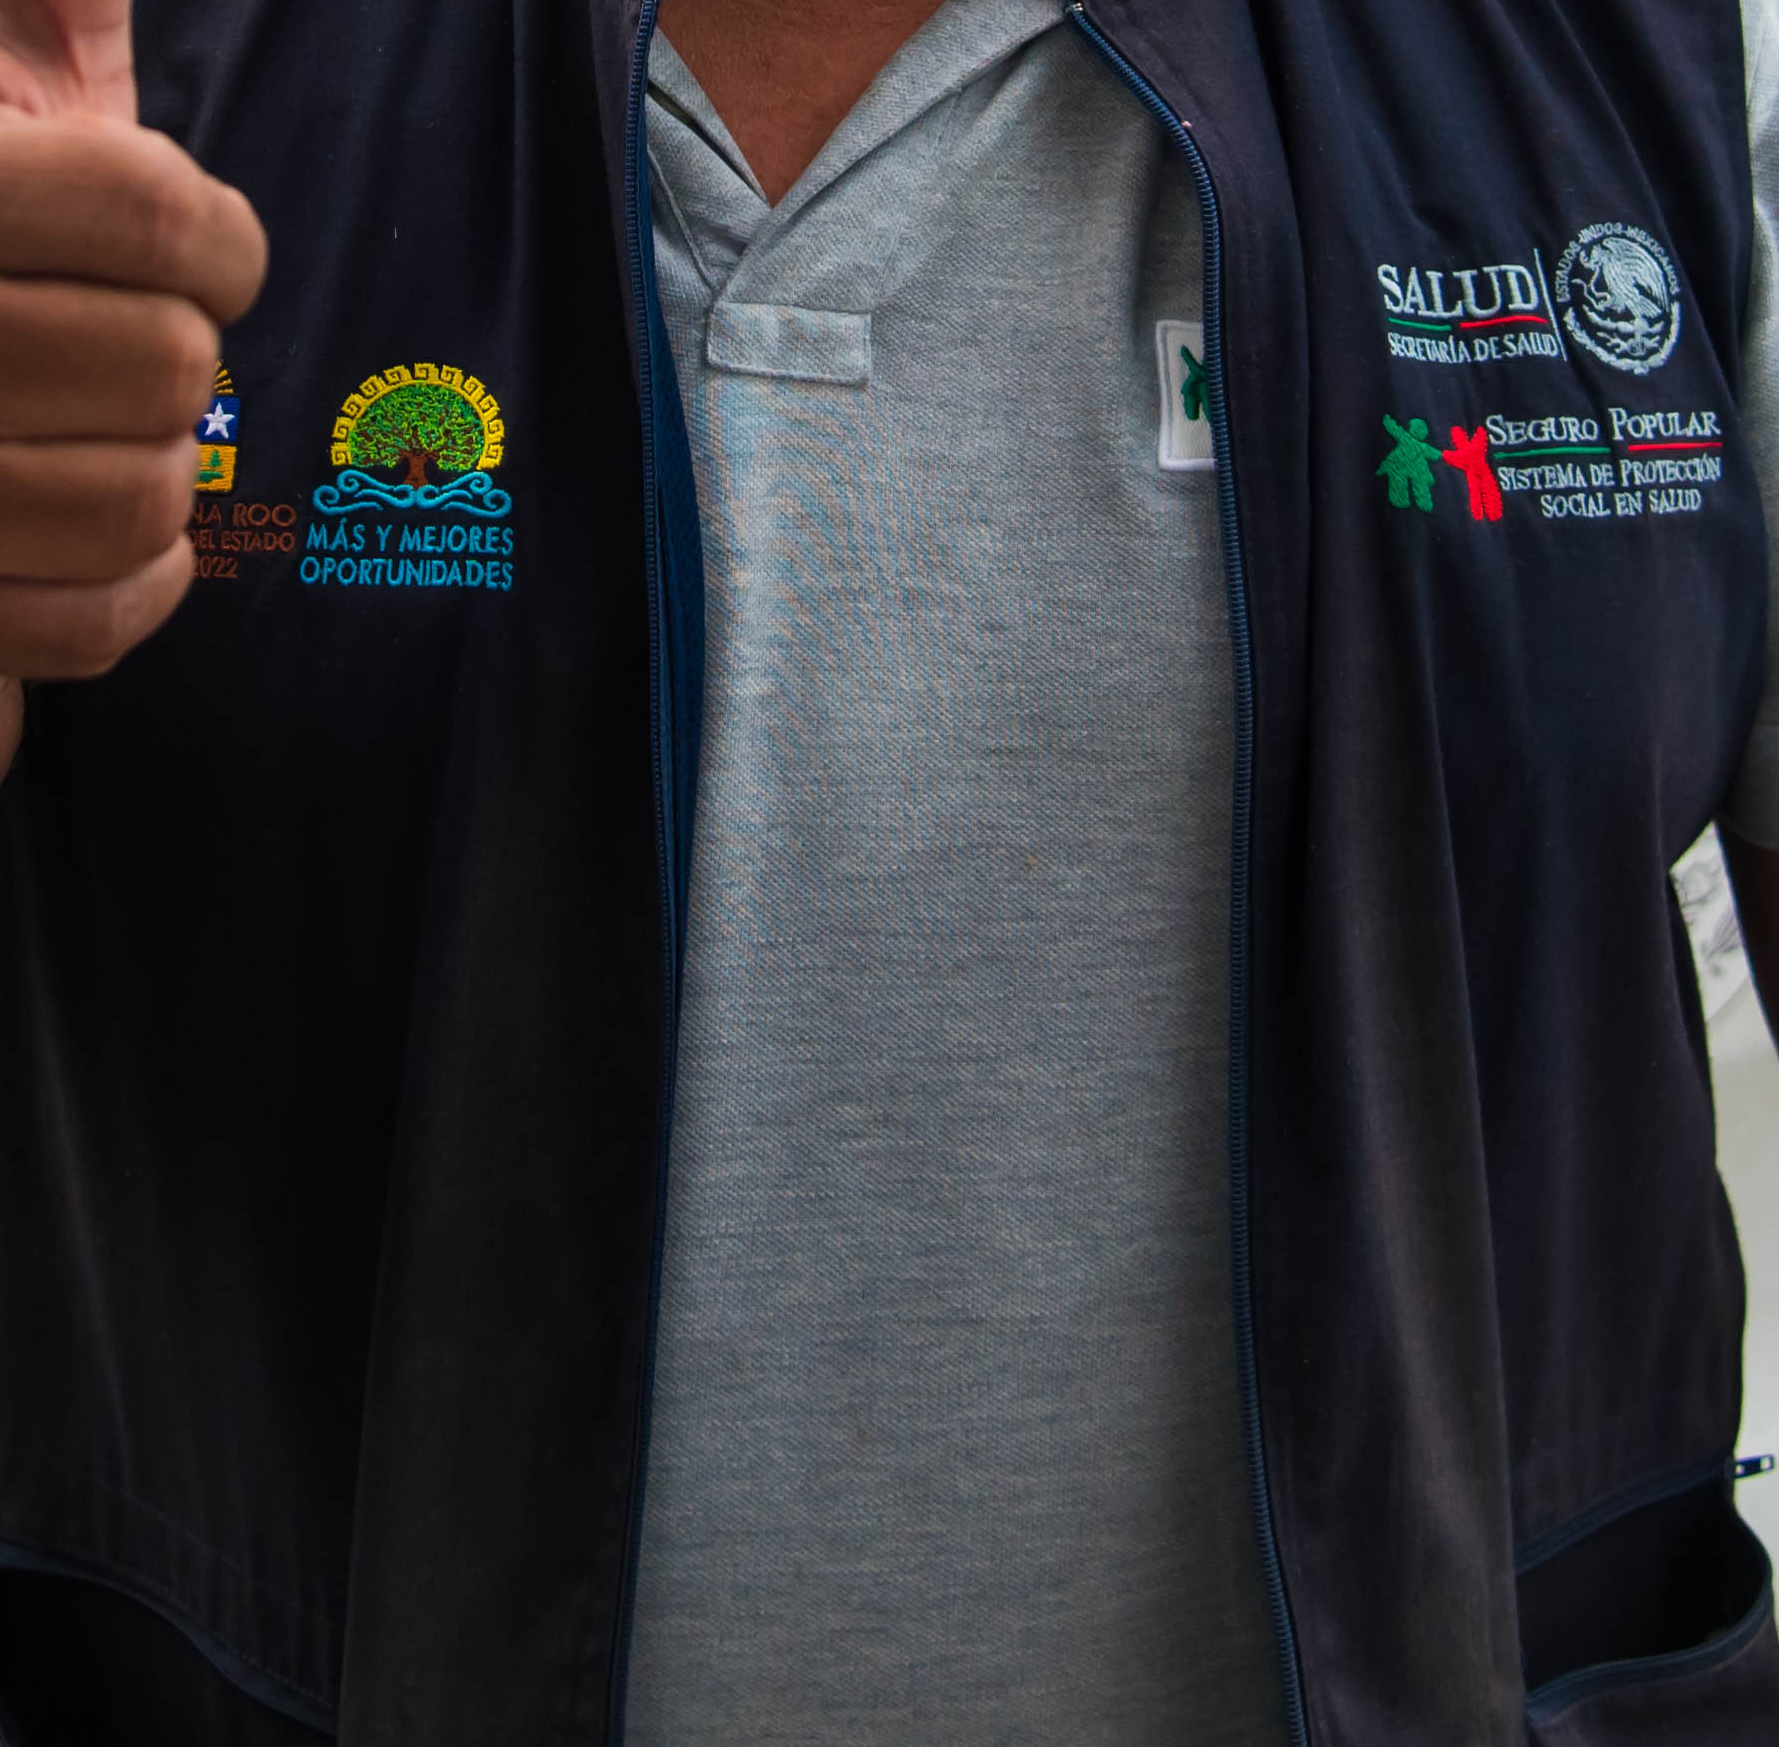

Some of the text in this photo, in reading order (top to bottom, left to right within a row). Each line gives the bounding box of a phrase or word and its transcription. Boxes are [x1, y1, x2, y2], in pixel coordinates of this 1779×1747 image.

[1377, 264, 1539, 318] SALUD
[1388, 332, 1560, 364] SECRETARÍA DE SALUD
[1486, 408, 1722, 446] SEGURO POPULAR
[1497, 453, 1722, 491] SISTEMA DE PROTECCIÓN
[232, 502, 297, 527] ROO
[1540, 488, 1703, 519] SOCIAL EN SALUD
[220, 531, 295, 552] ESTADO
[306, 517, 514, 556] MÁS Y MEJORES
[300, 556, 514, 591] OPORTUNIDADES
